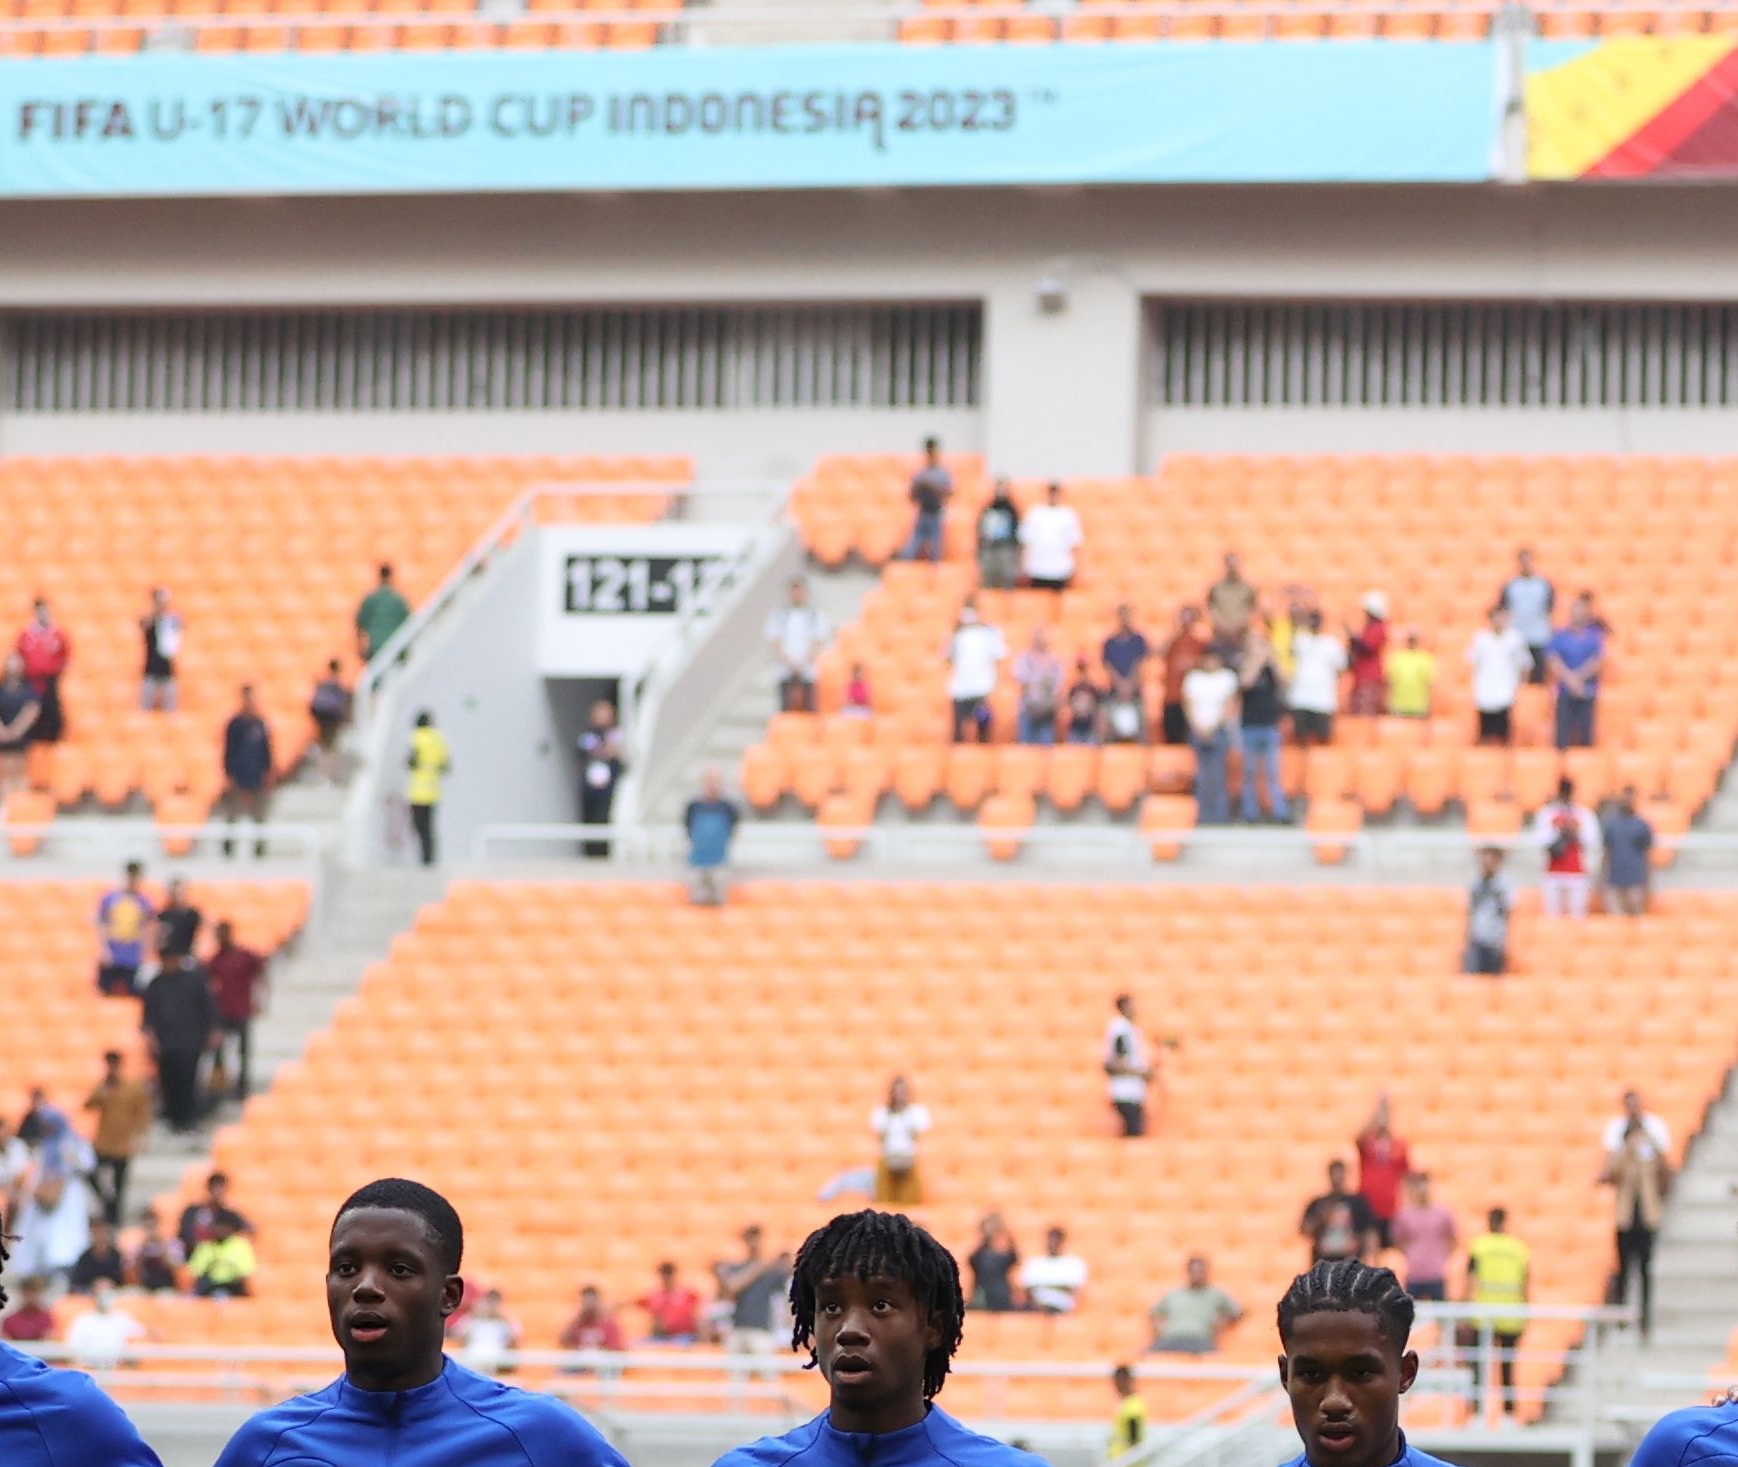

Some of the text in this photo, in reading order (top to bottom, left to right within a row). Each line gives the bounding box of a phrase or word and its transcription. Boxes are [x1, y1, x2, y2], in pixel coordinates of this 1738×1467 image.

[19, 89, 1017, 151] FIFA U-17 WORLD CUP INDONESIA 2023
